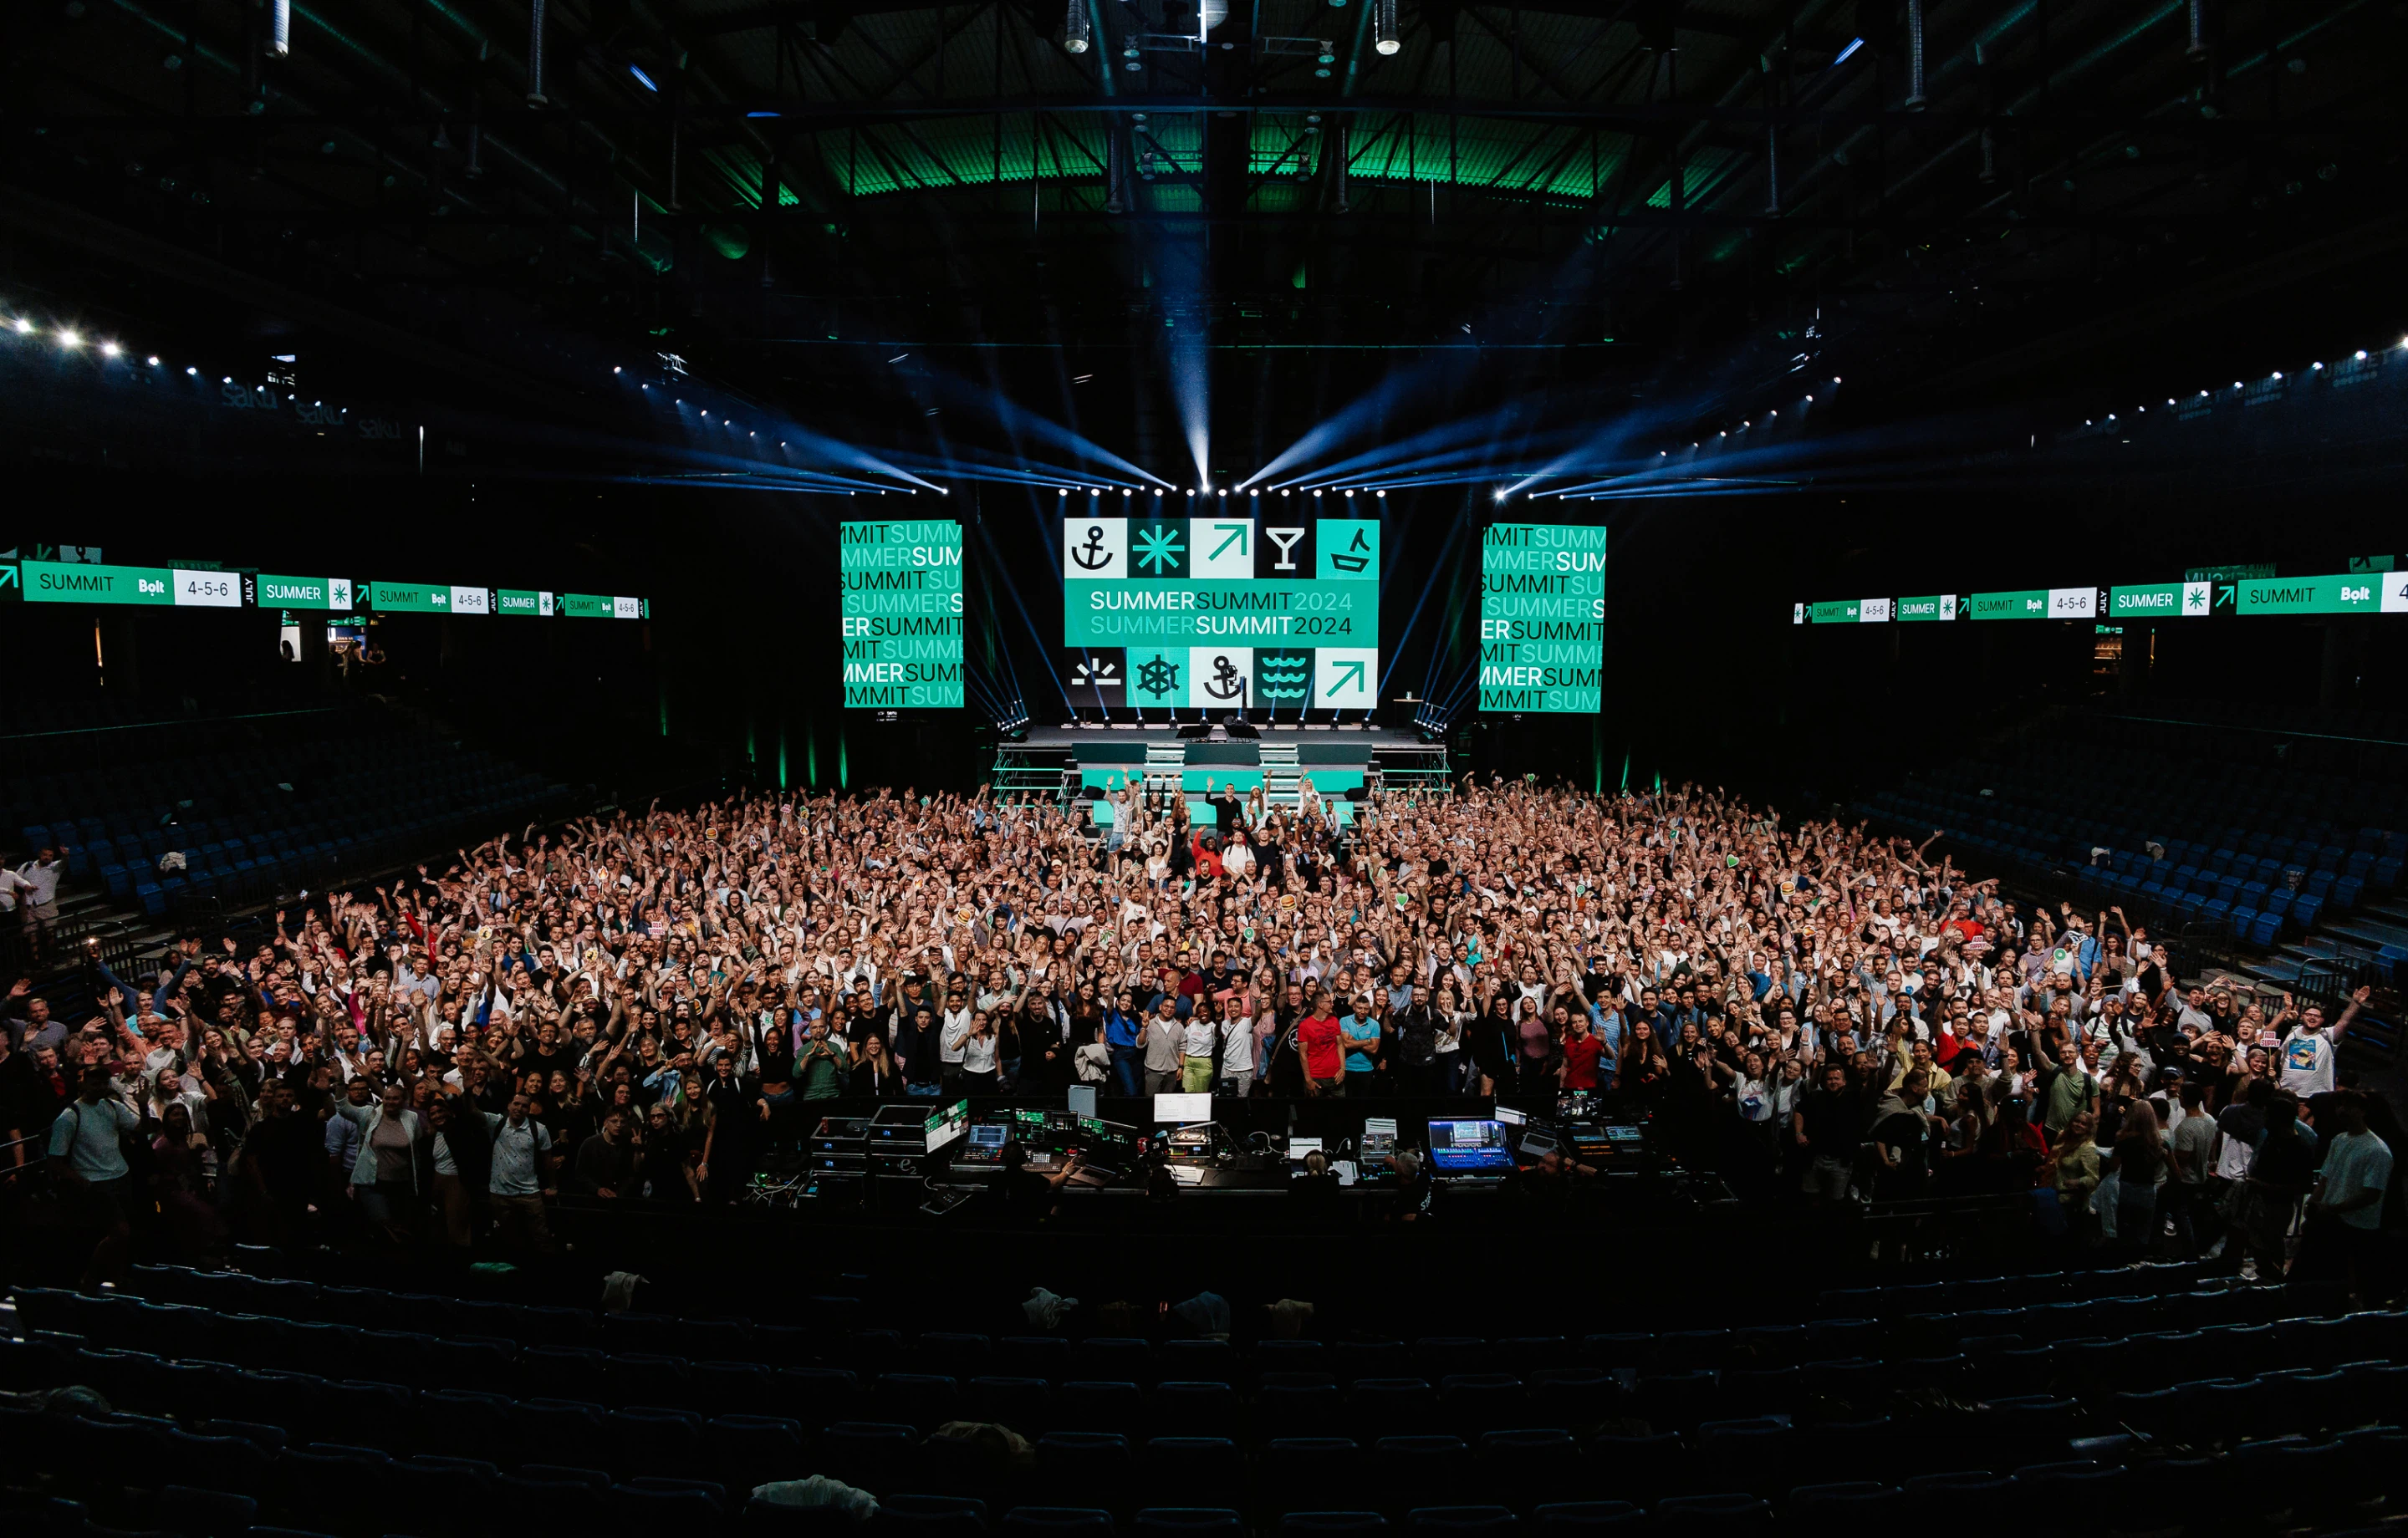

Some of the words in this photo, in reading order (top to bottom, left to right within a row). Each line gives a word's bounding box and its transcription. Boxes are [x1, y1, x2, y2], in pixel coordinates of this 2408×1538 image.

[39, 573, 114, 592] SUMMIT
[188, 581, 228, 596] 4-5-6
[245, 578, 253, 603] JULY
[266, 585, 321, 600] SUMMER
[380, 590, 419, 603] SUMMIT
[2249, 588, 2316, 603] SUMMIT
[458, 595, 482, 605] 4-5-6
[503, 597, 534, 609] SUMMER
[570, 600, 594, 610] SUMMIT
[1977, 600, 2013, 612] SUMMIT
[2057, 597, 2086, 609] 4-5-6
[2118, 593, 2173, 608] SUMMER
[619, 603, 634, 612] 4-5-6
[1816, 608, 1839, 617] SUMMIT
[1865, 605, 1884, 614] 4-5-6
[1902, 603, 1935, 614] SUMMER
